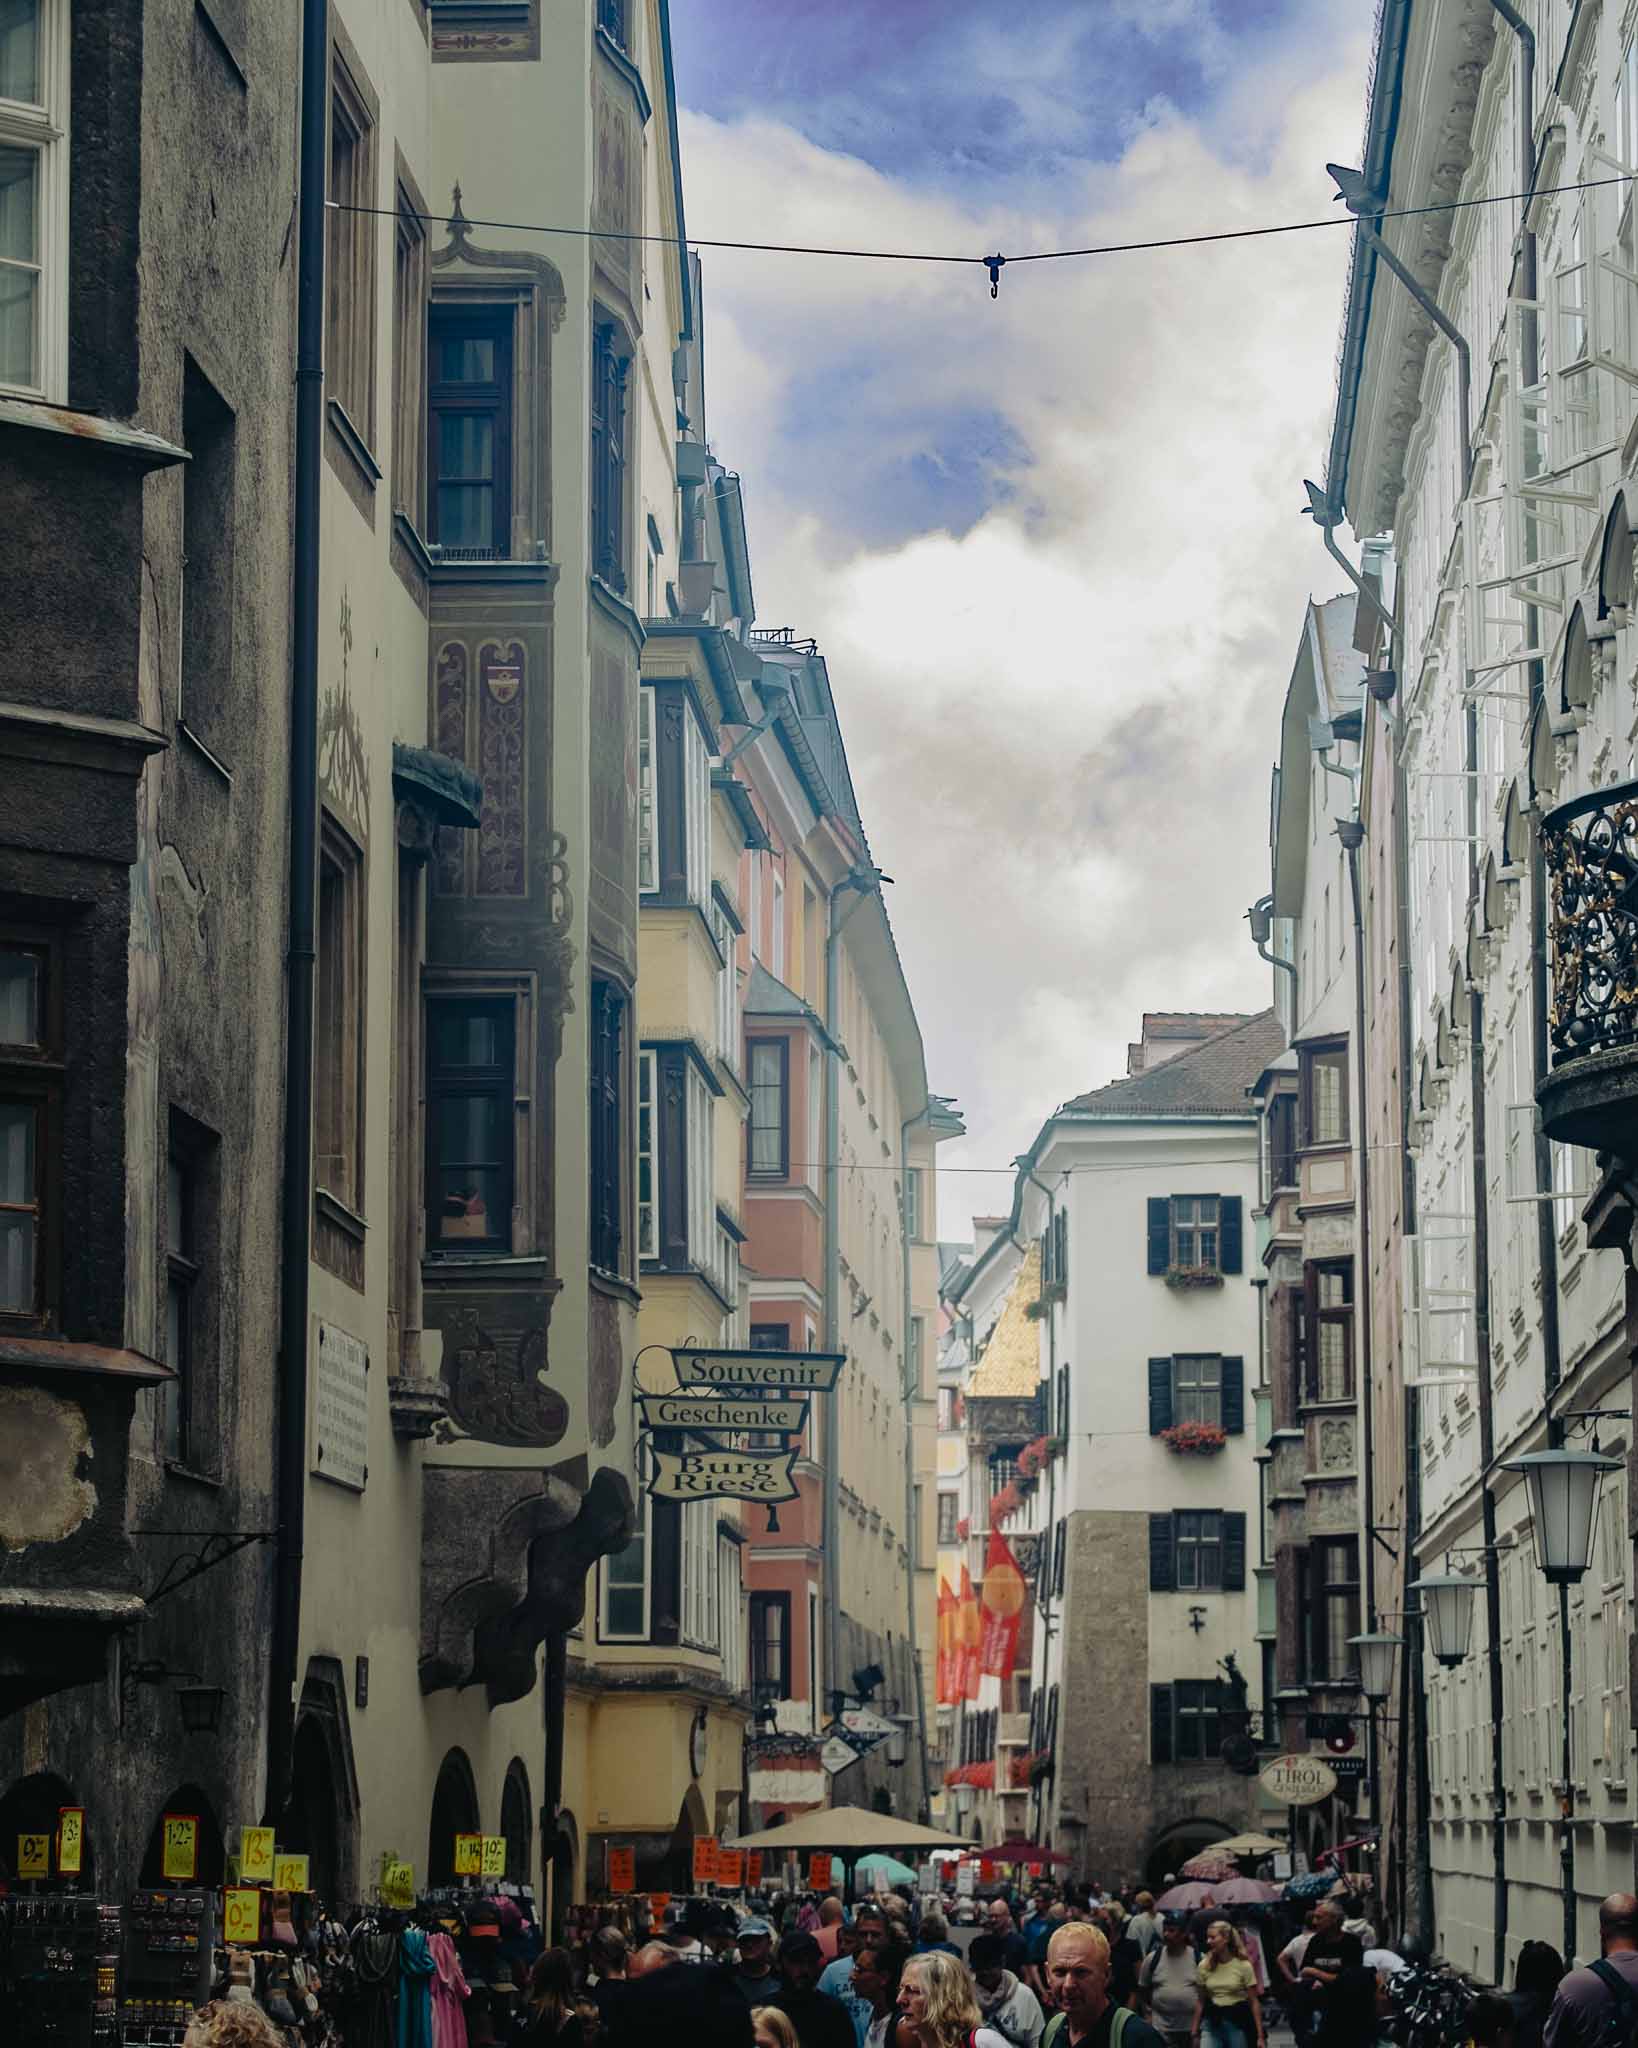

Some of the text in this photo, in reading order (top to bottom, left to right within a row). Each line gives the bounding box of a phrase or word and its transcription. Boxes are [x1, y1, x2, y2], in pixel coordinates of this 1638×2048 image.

[690, 1357, 821, 1384] Souvenir
[658, 1401, 788, 1425] Geschenke
[680, 1456, 774, 1481] Burg
[672, 1473, 778, 1492] Riese
[1272, 1767, 1326, 1785] TIROL
